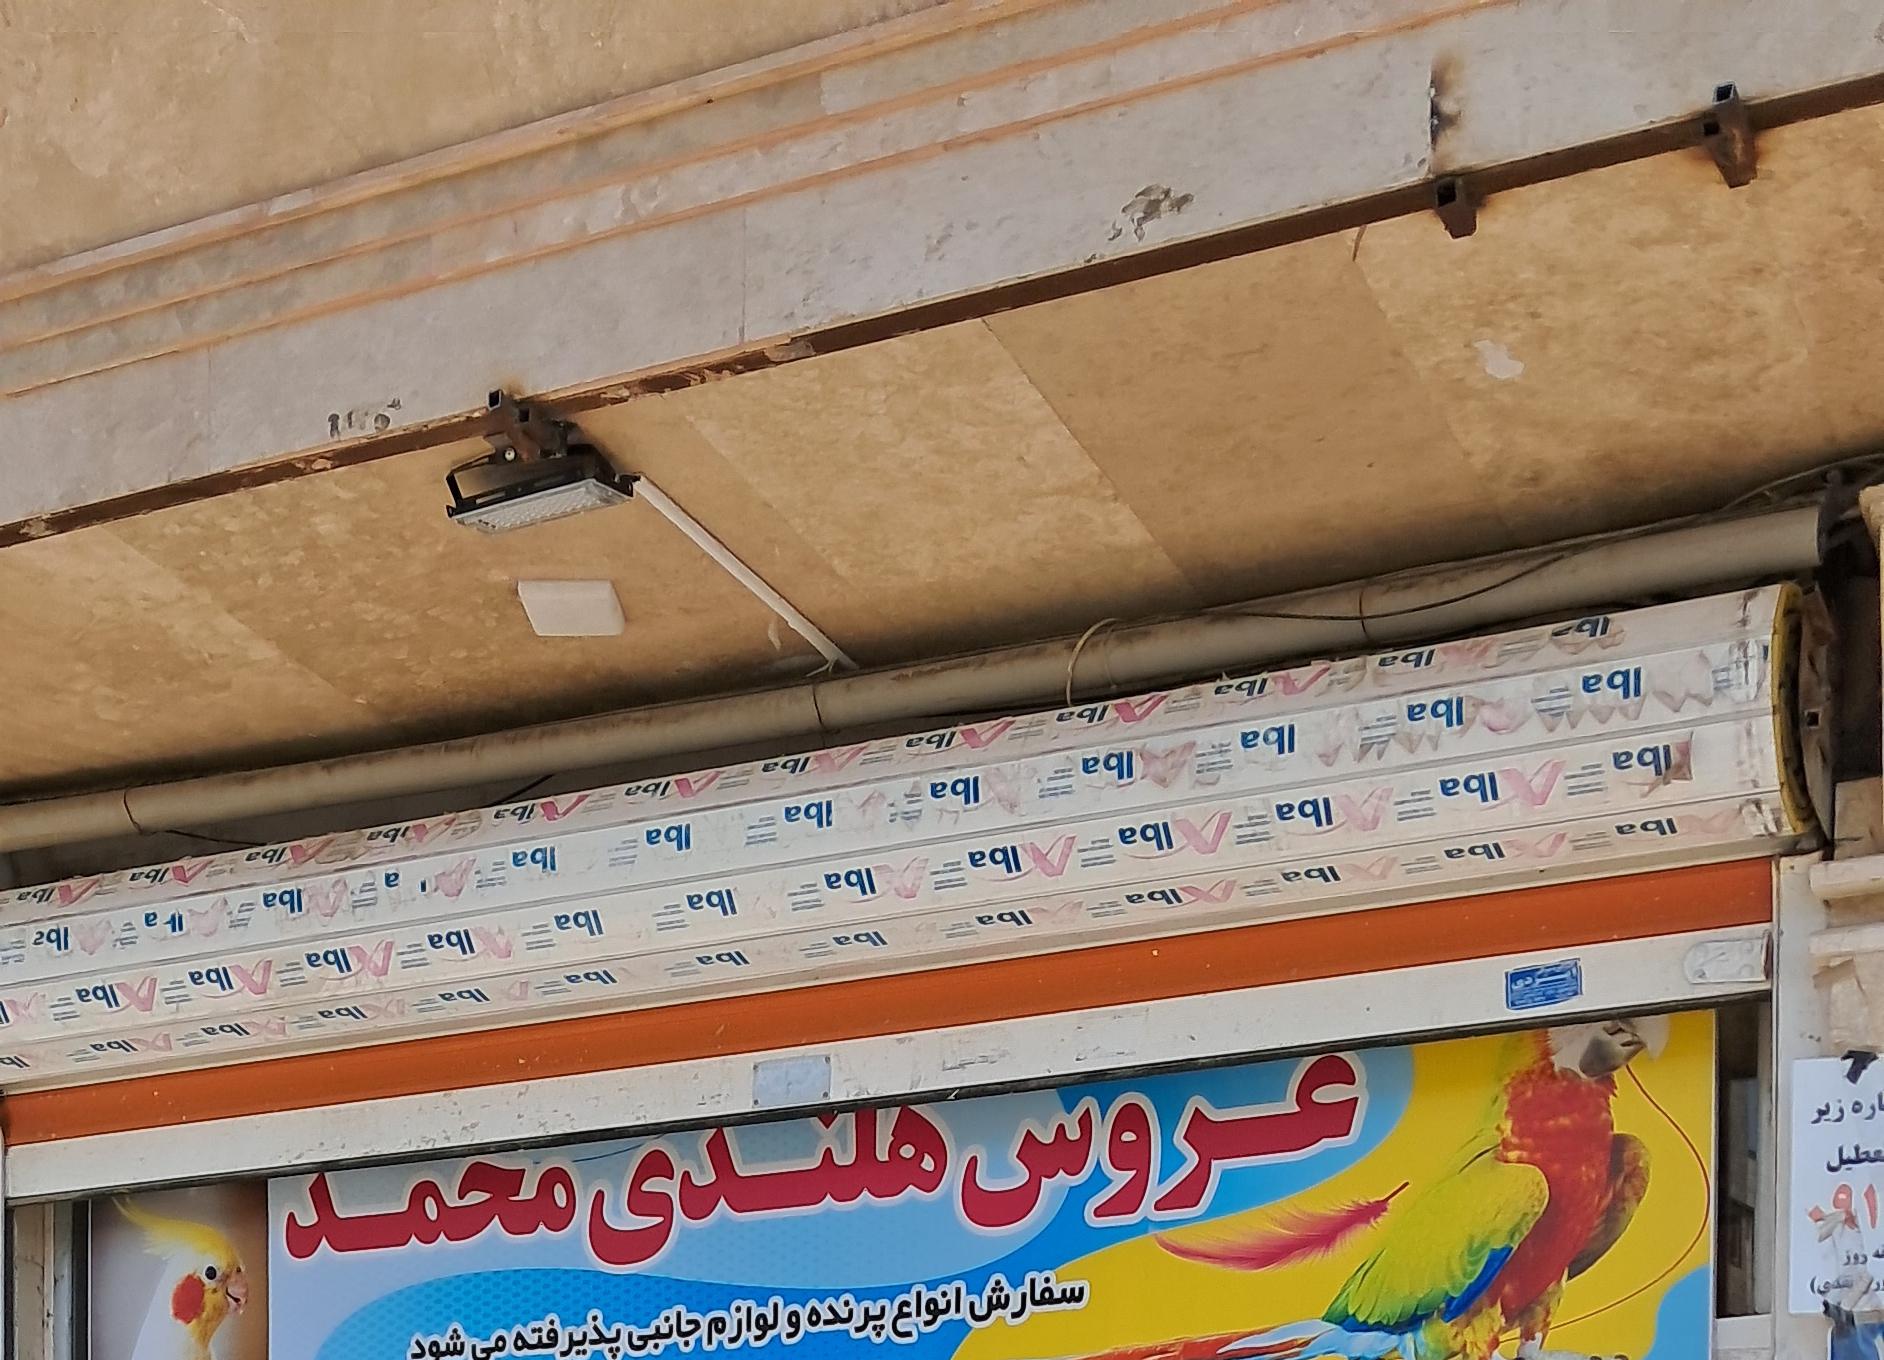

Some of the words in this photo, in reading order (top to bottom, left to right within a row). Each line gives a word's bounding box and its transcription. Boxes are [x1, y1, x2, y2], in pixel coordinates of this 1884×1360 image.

[1811, 1098, 1844, 1125] زیر
[1851, 1090, 1884, 1121] اره
[960, 1054, 1359, 1228] عروس
[1826, 1143, 1884, 1173] عطیل
[588, 1104, 948, 1267] هلندی
[286, 1160, 576, 1259] محمد
[807, 1298, 887, 1338] پرنده
[892, 1286, 961, 1338] انواع
[969, 1275, 1085, 1323] سفارش
[513, 1314, 622, 1360] پذیرفته
[628, 1310, 701, 1355] جانبی
[706, 1300, 779, 1346] لوازم
[785, 1313, 801, 1339] و
